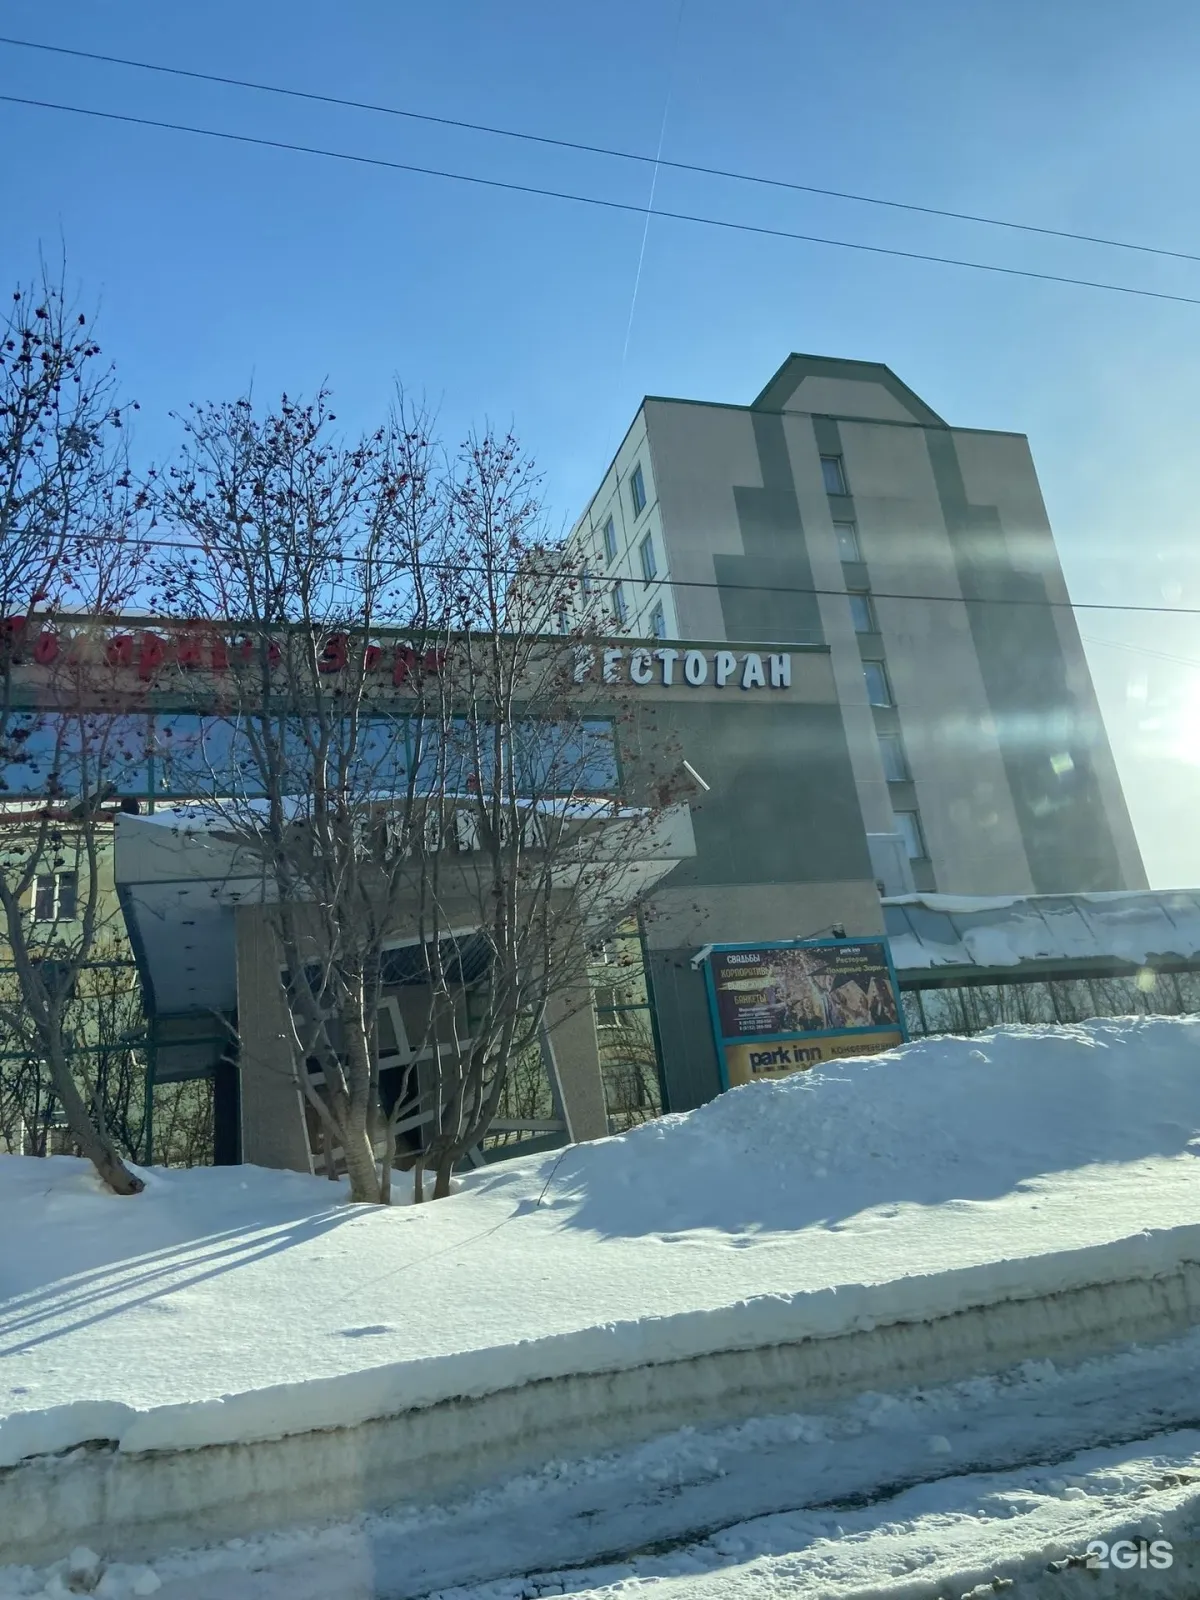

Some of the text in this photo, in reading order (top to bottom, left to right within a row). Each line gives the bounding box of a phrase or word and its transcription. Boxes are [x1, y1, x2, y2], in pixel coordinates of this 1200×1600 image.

[573, 645, 792, 689] РЕСТОРАН
[726, 954, 761, 964] СВАДЬБЫ
[835, 956, 868, 964] Ресторан
[733, 993, 768, 1005] БАНКЕТЫ
[749, 1046, 792, 1074] park
[794, 1044, 823, 1062] inn
